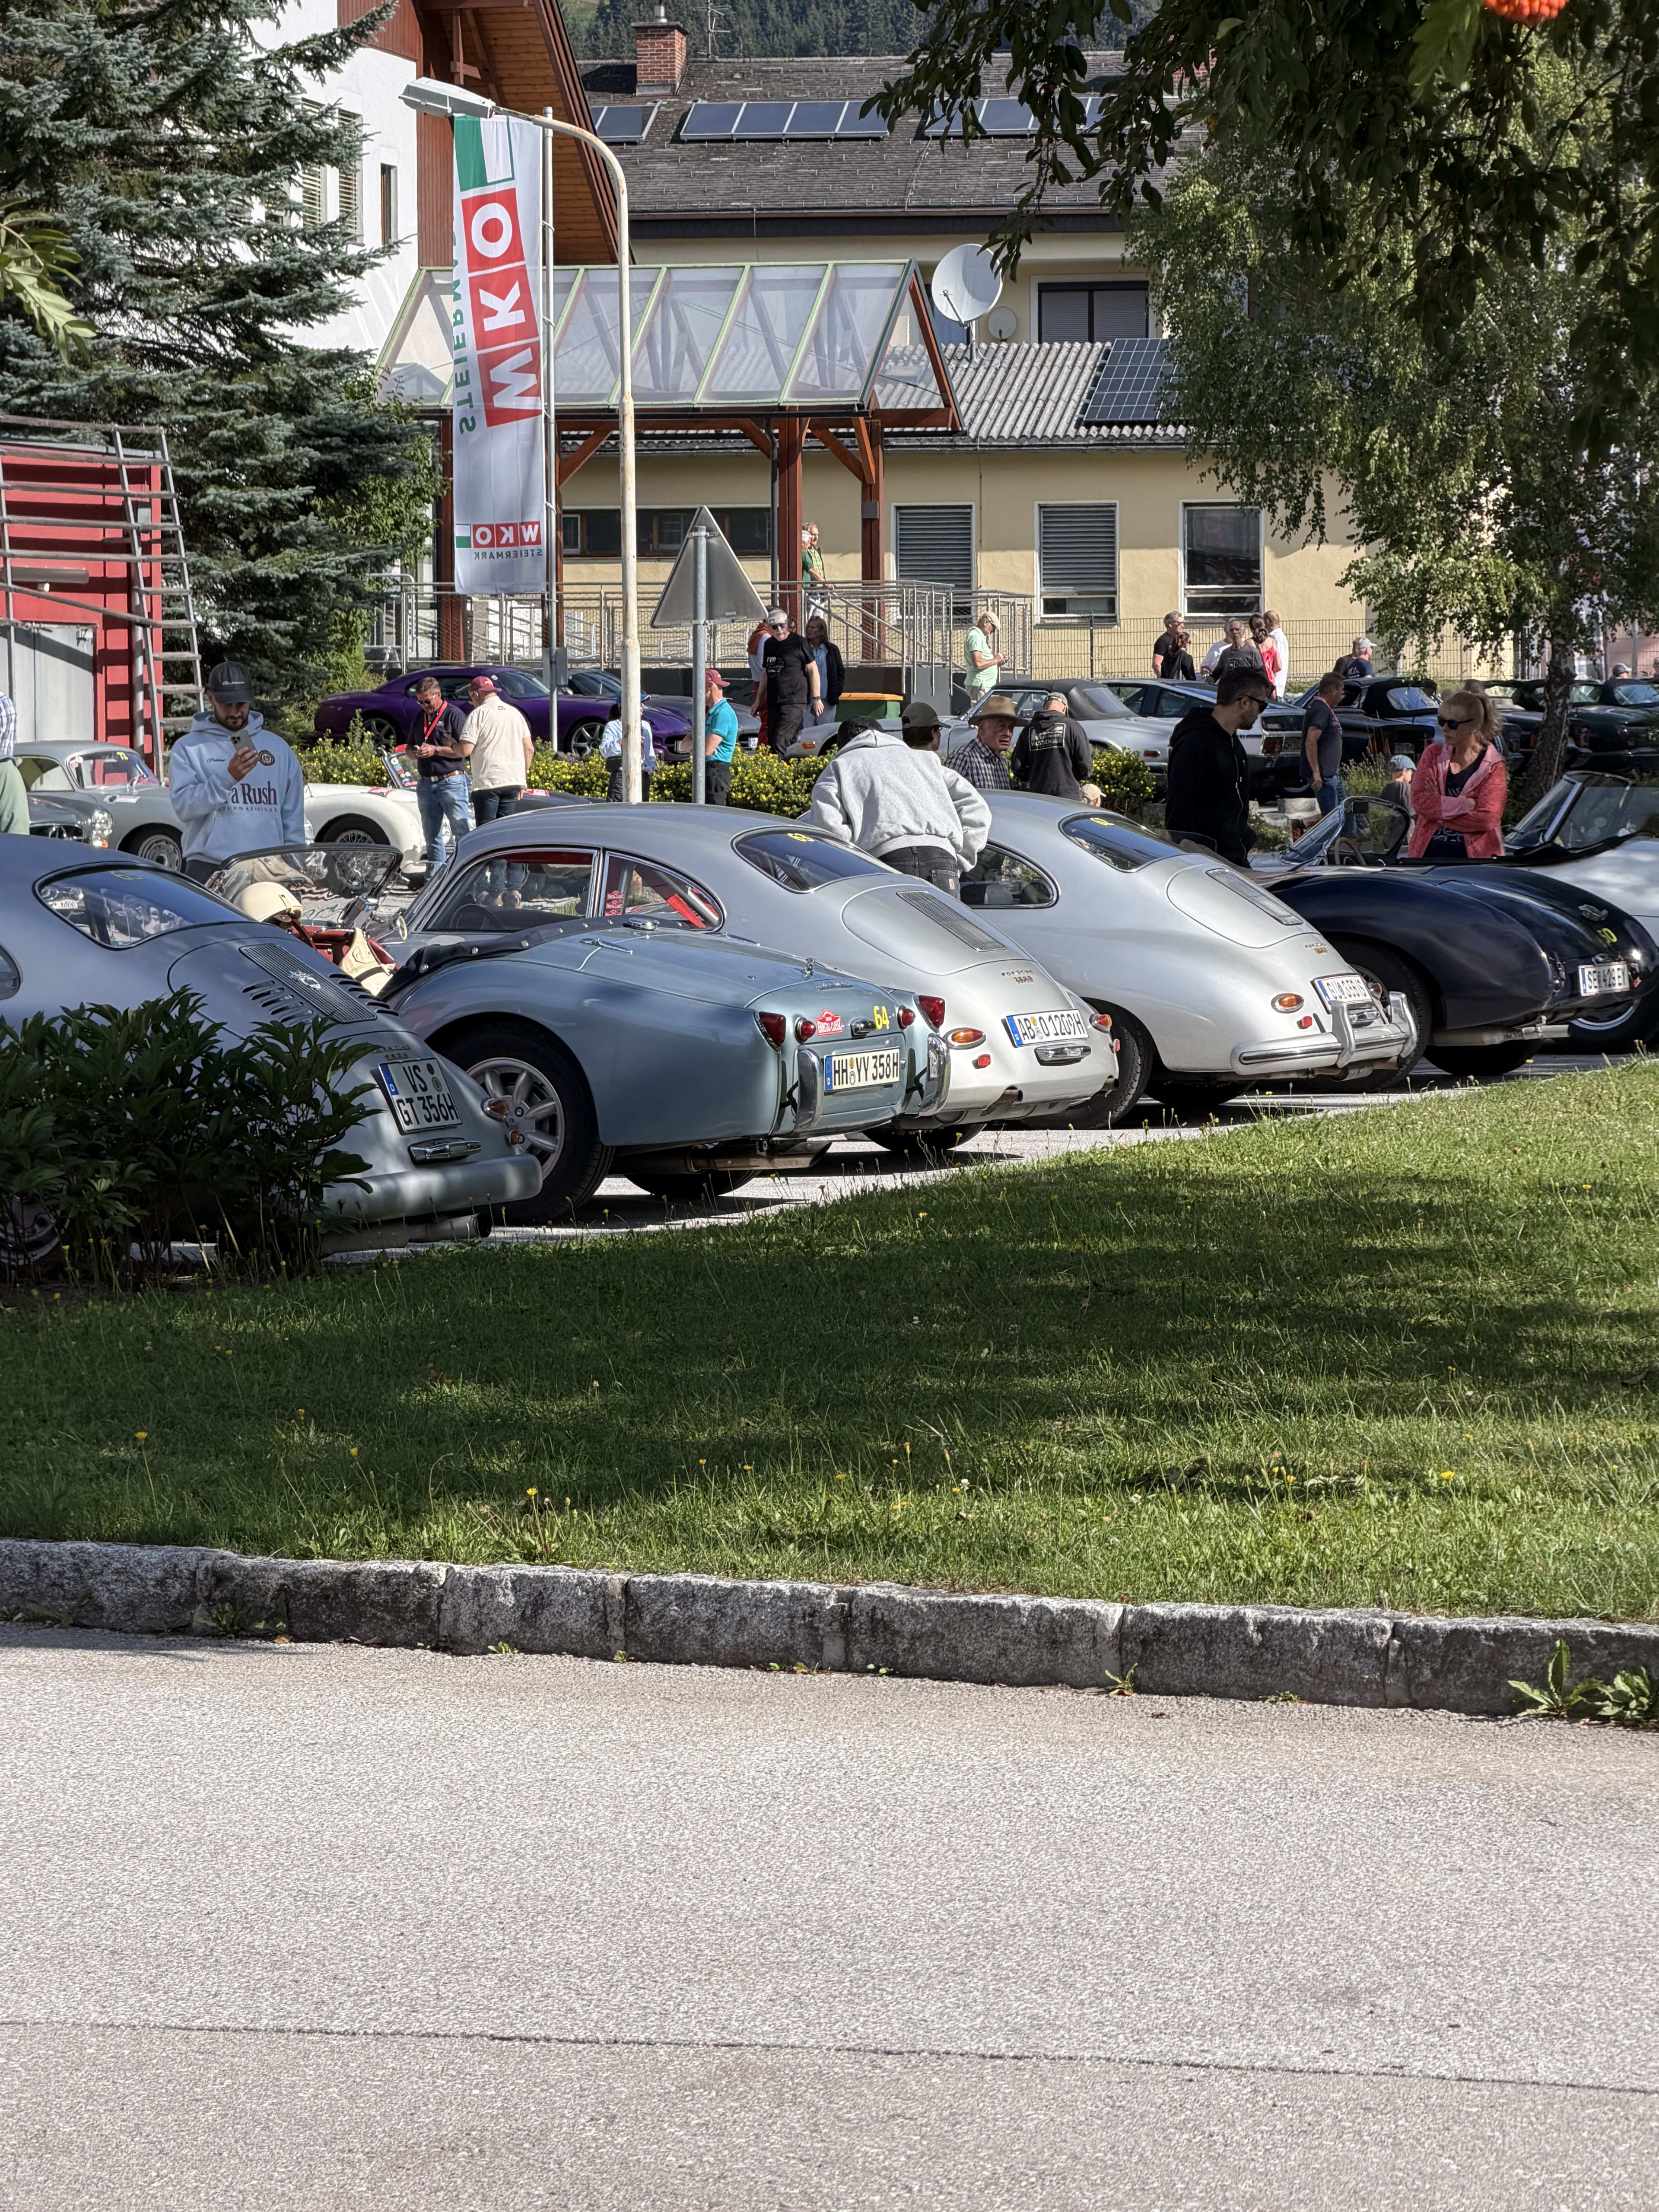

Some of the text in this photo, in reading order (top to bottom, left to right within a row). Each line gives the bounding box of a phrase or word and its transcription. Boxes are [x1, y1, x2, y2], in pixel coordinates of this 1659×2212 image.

[240, 781, 278, 805] Rush
[787, 833, 815, 842] 63
[1326, 981, 1342, 1000] GU
[1587, 970, 1598, 990] SE
[1617, 967, 1626, 986] EY
[873, 1005, 890, 1030] 64
[1017, 1018, 1036, 1041] AB
[1048, 1013, 1085, 1036] 1209H
[402, 1065, 428, 1093] VS
[833, 1052, 899, 1086] HH YY 358H
[396, 1093, 459, 1126] GT 356H
